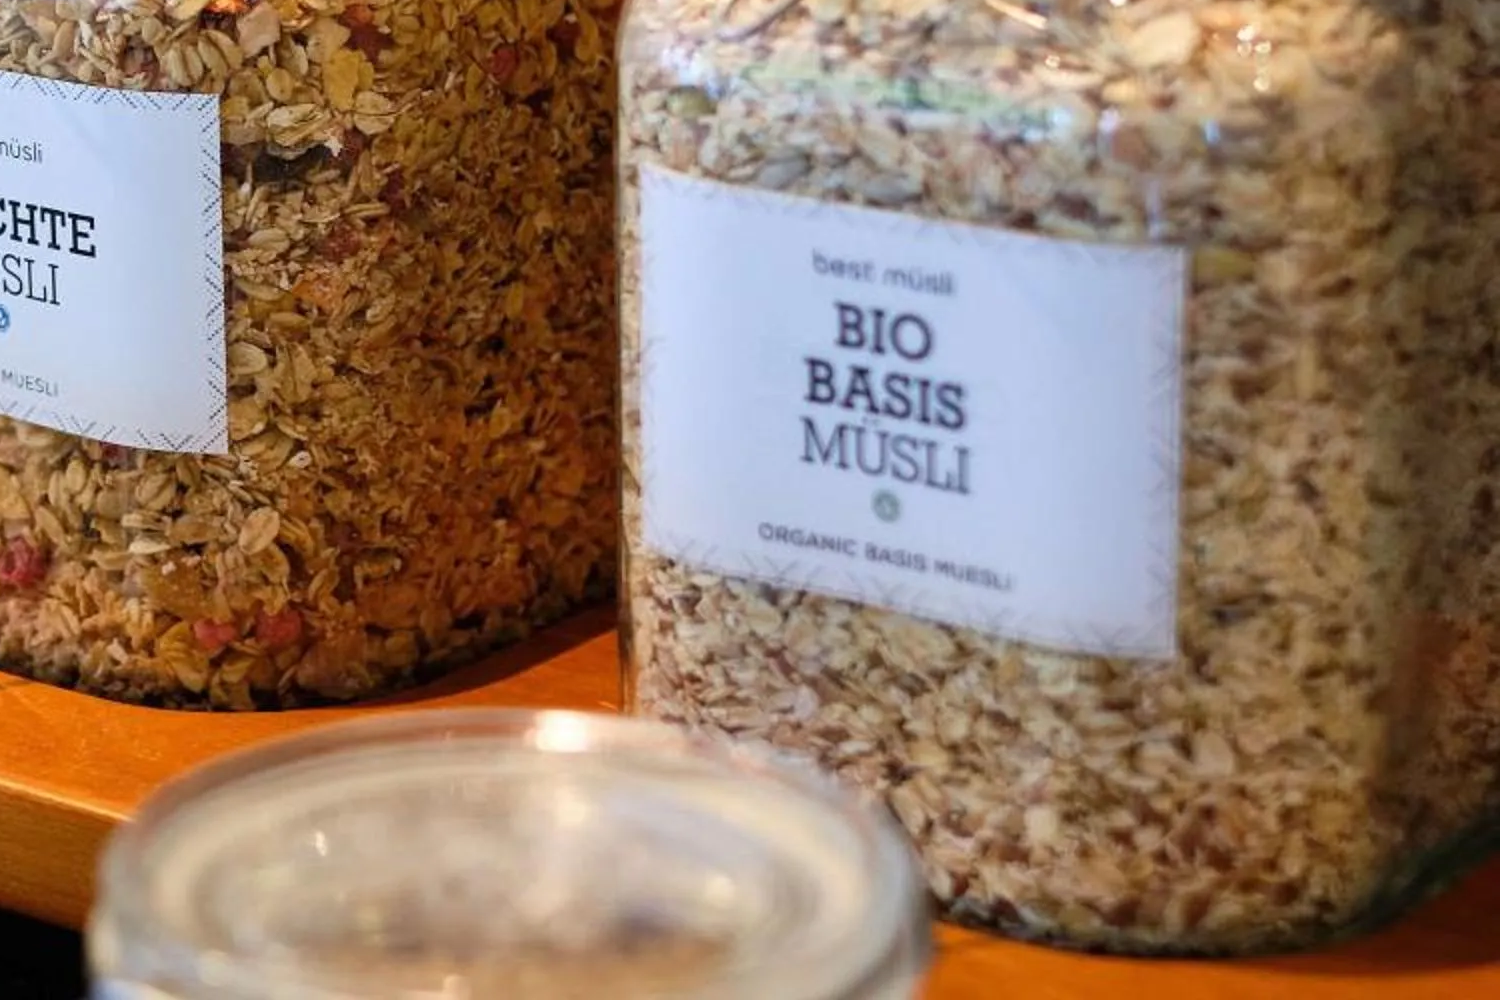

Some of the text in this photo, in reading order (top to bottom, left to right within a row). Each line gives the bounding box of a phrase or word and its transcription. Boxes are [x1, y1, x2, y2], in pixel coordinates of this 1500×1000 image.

[812, 249, 955, 297] best müsli
[834, 301, 934, 361] BIO
[1, 370, 59, 397] MUESLI
[803, 357, 967, 430] BASIS
[800, 417, 971, 496] MÜSLI
[758, 522, 1013, 592] ORGANIC BASIS MUESLI
